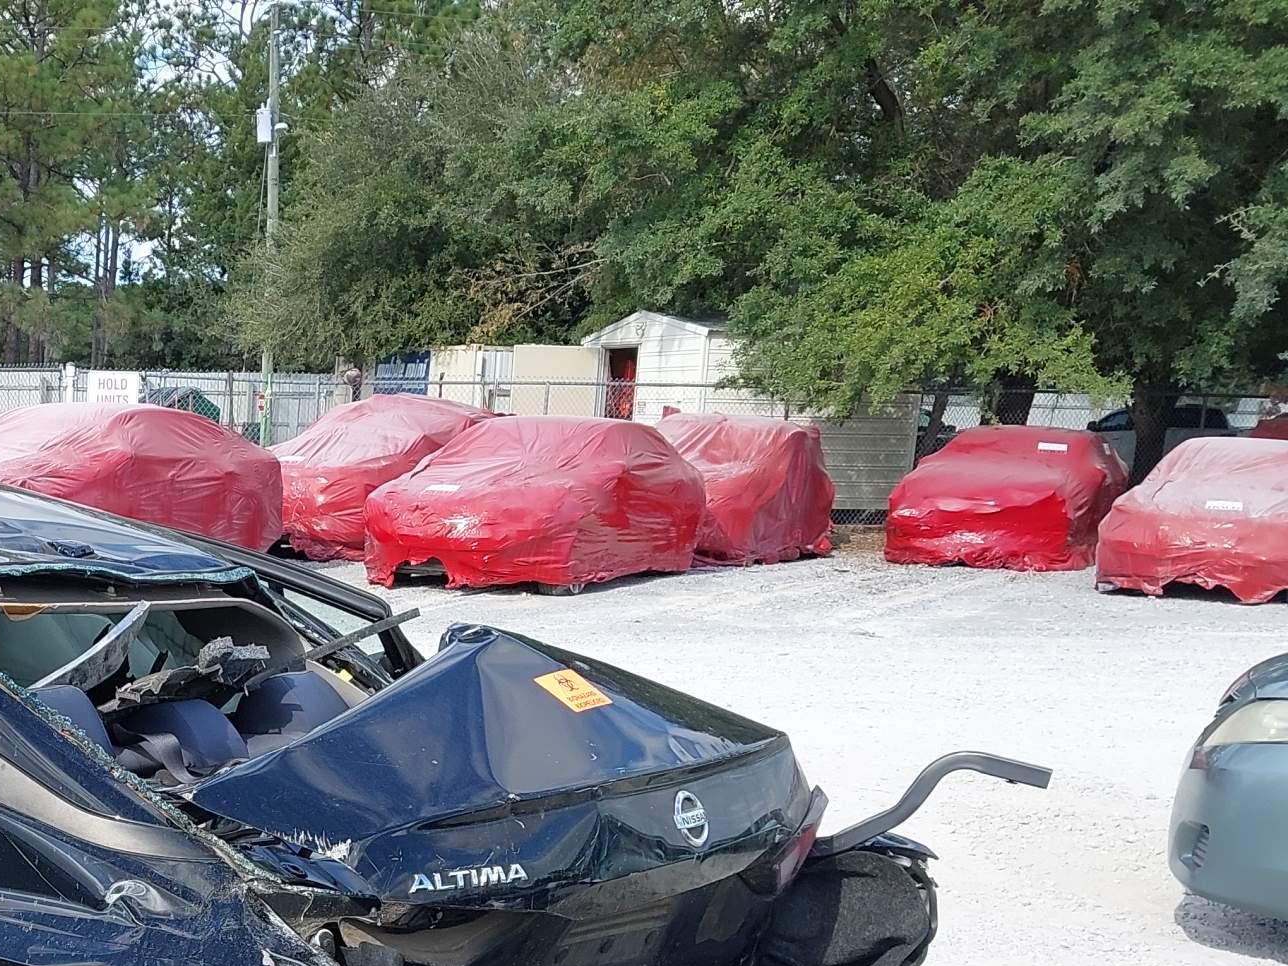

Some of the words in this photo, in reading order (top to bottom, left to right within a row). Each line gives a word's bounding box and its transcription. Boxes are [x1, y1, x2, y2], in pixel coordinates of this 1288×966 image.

[98, 377, 128, 390] HOLD
[681, 811, 708, 826] NISSA
[408, 863, 529, 894] ALTIMA
